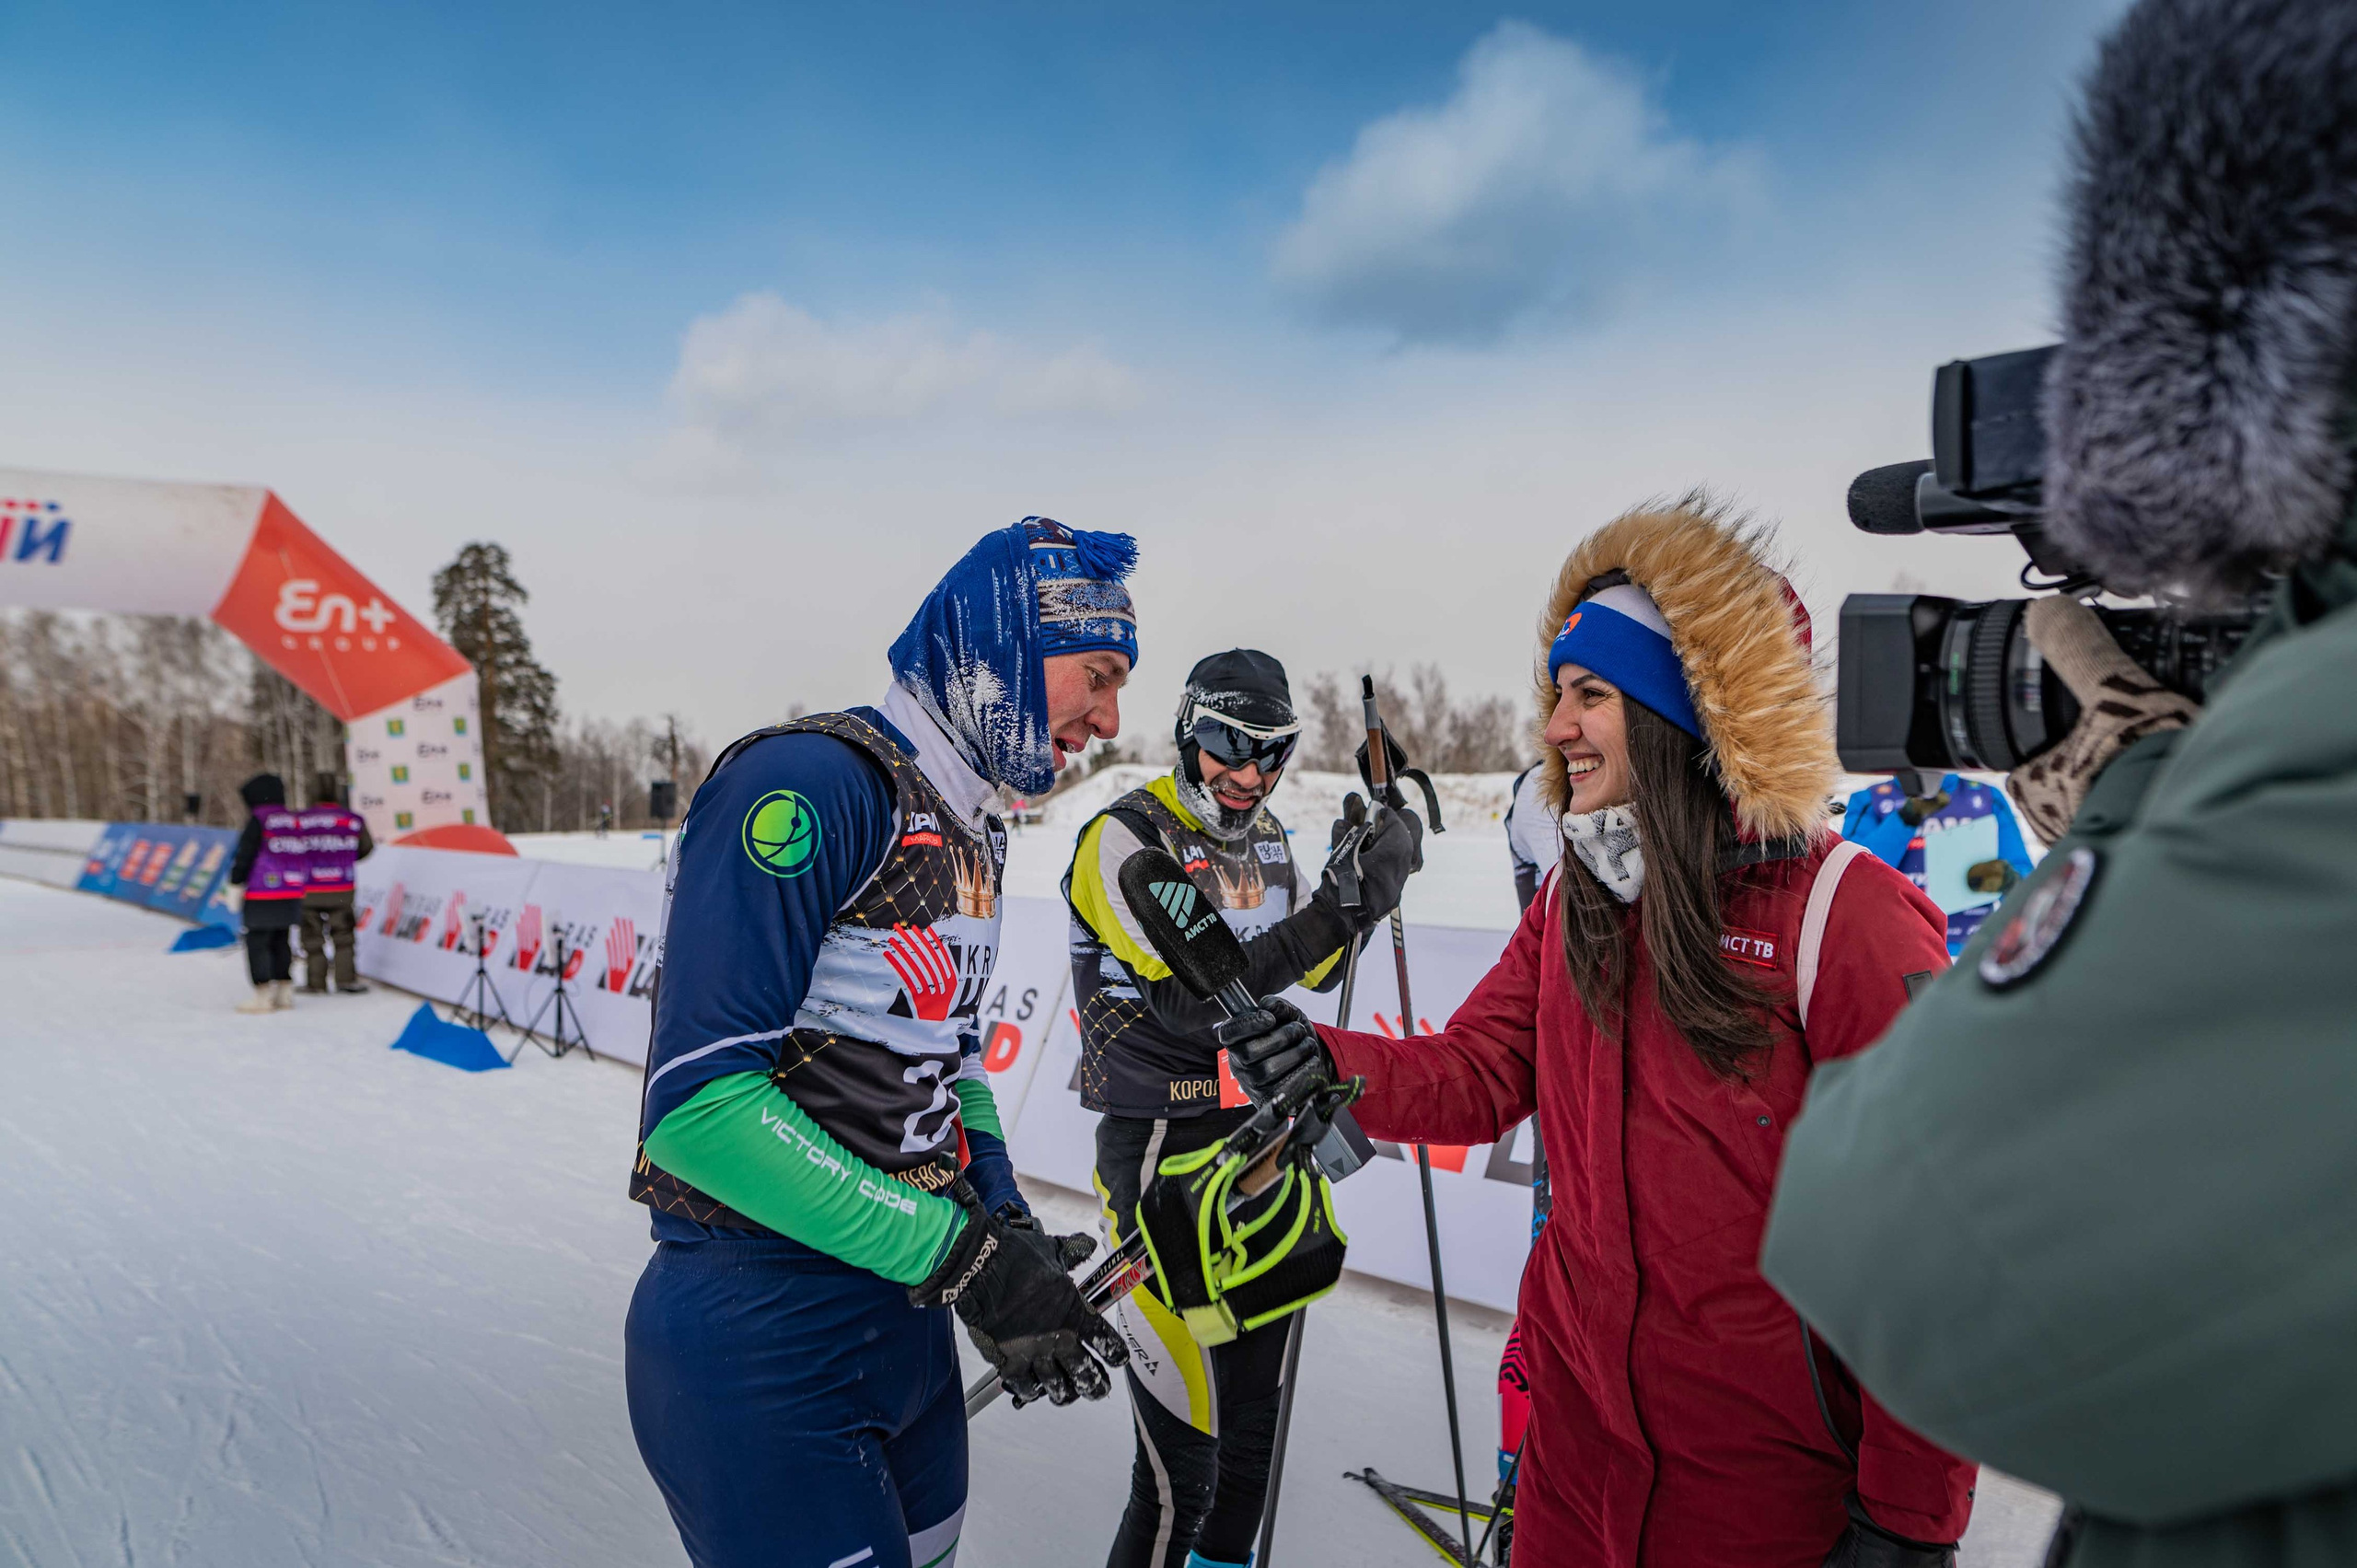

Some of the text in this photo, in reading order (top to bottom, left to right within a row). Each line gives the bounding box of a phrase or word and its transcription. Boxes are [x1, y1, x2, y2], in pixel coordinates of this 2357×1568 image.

[1184, 917, 1210, 941] АИСТ
[967, 945, 998, 975] KR
[1753, 940, 1774, 958] ТВ
[761, 1106, 918, 1216] VICTORY CODE
